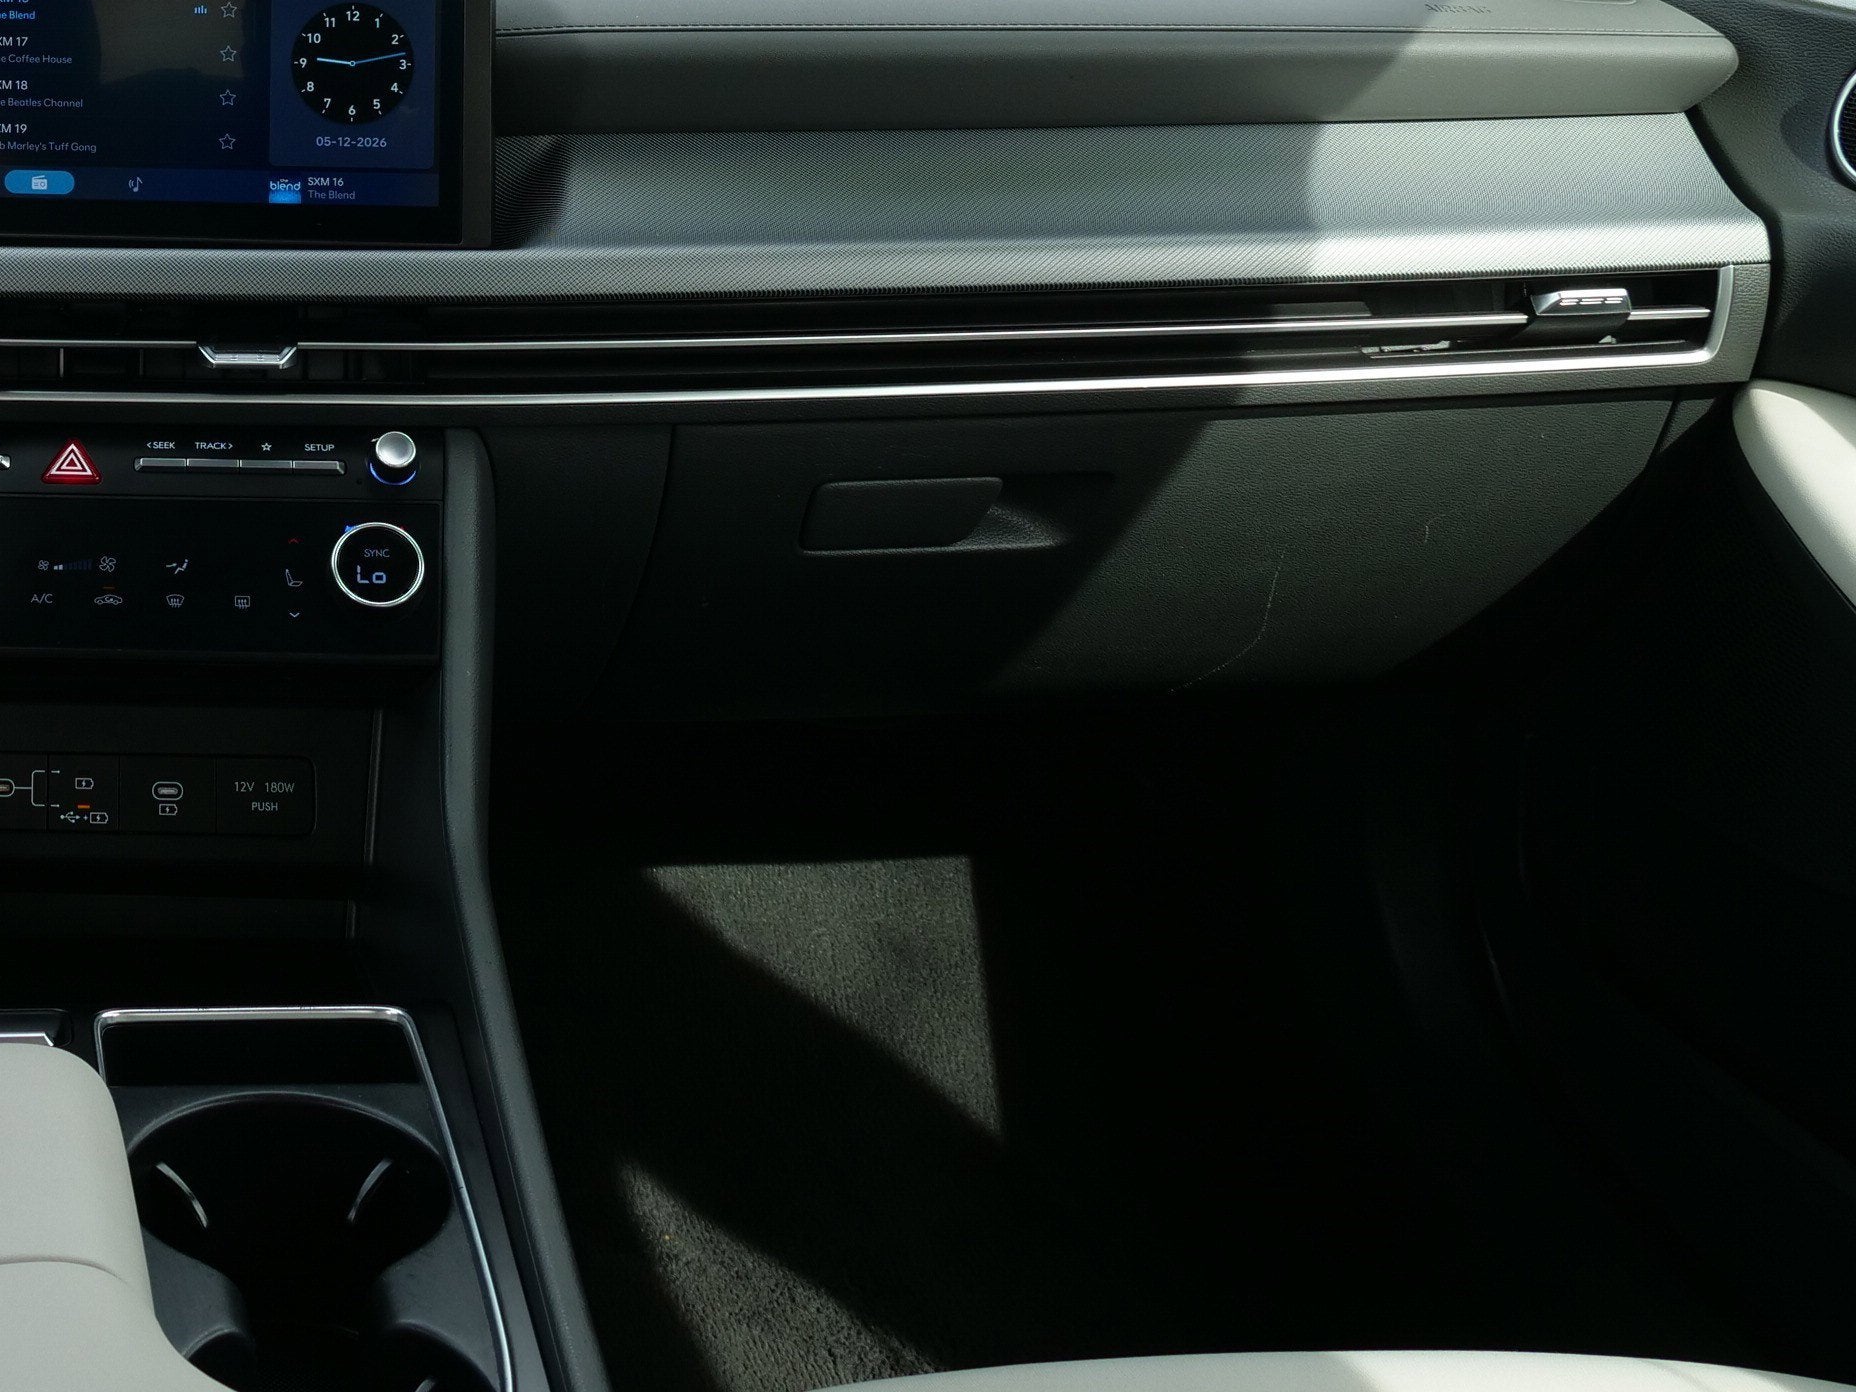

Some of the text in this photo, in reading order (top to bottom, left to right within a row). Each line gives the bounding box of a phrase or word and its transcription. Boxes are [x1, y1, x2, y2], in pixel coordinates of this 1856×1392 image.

[9, 10, 36, 20] Blend
[346, 10, 360, 22] 12
[324, 17, 336, 27] 11
[374, 18, 380, 28] 1
[16, 36, 29, 46] 17
[307, 33, 321, 44] 10
[391, 34, 399, 45] 2
[8, 54, 41, 63] Coffee
[42, 55, 73, 64] House
[299, 58, 307, 68] 9
[399, 59, 407, 70] 3
[15, 80, 28, 90] 18
[306, 81, 315, 92] 8
[390, 82, 399, 92] 4
[7, 97, 42, 107] Beatles
[44, 98, 83, 108] Channel
[324, 98, 332, 108] 7
[373, 99, 381, 109] 5
[348, 105, 356, 115] 6
[14, 123, 28, 133] 19
[315, 136, 387, 148] 05-12-2026
[7, 141, 47, 152] Marley's
[49, 142, 69, 151] Tuff
[70, 142, 97, 154] Gong
[270, 181, 301, 190] blend
[308, 177, 344, 186] SXM 16
[308, 189, 356, 199] The Blend
[364, 548, 390, 558] SYNC
[31, 593, 54, 604] A/C
[234, 781, 295, 793] 12V 180W
[251, 801, 278, 812] PUSH
